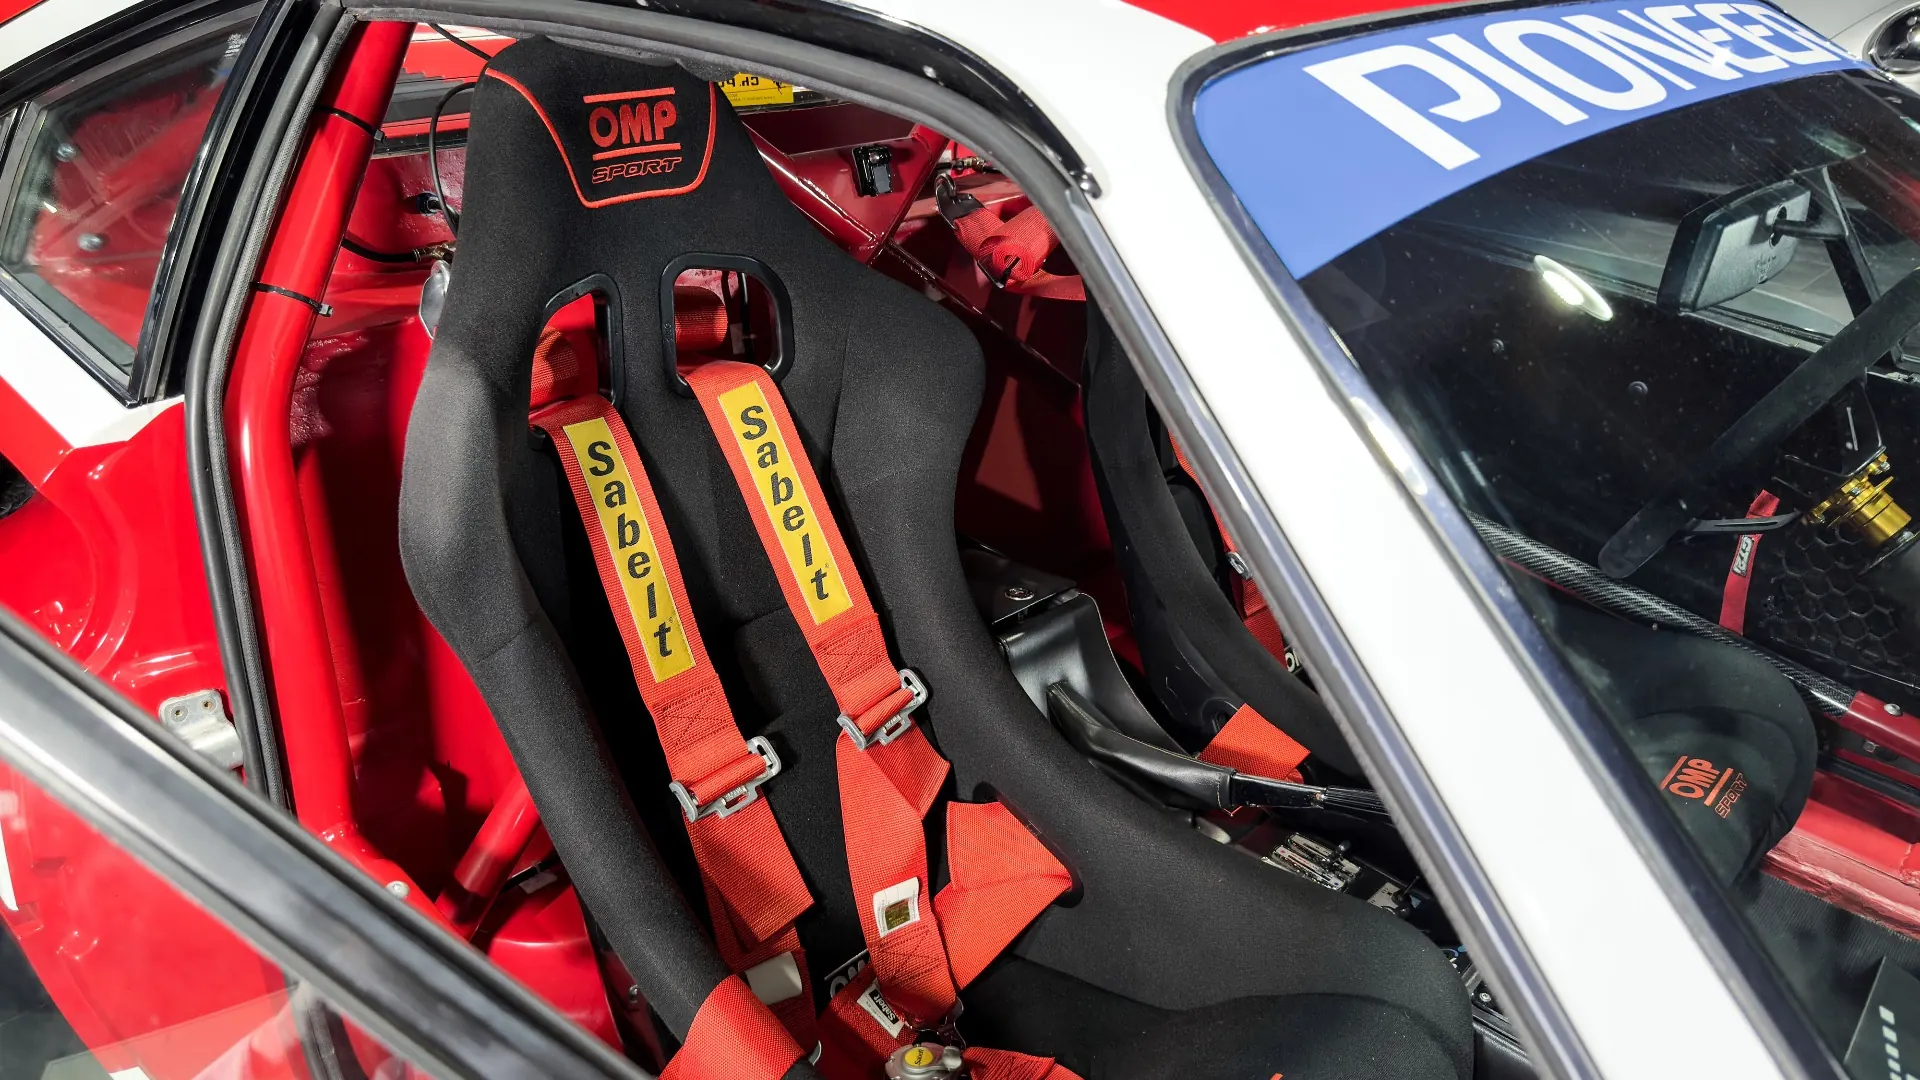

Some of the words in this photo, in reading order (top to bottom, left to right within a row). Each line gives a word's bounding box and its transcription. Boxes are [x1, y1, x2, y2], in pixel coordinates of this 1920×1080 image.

[1303, 3, 1860, 171] PIONEER
[589, 100, 677, 148] OMP
[592, 156, 682, 184] SPORT
[739, 404, 829, 601] Sabelt
[587, 440, 673, 658] Sabelt
[1668, 758, 1720, 799] OMP
[1714, 772, 1748, 819] SPORT
[872, 992, 897, 1022] Sabelt
